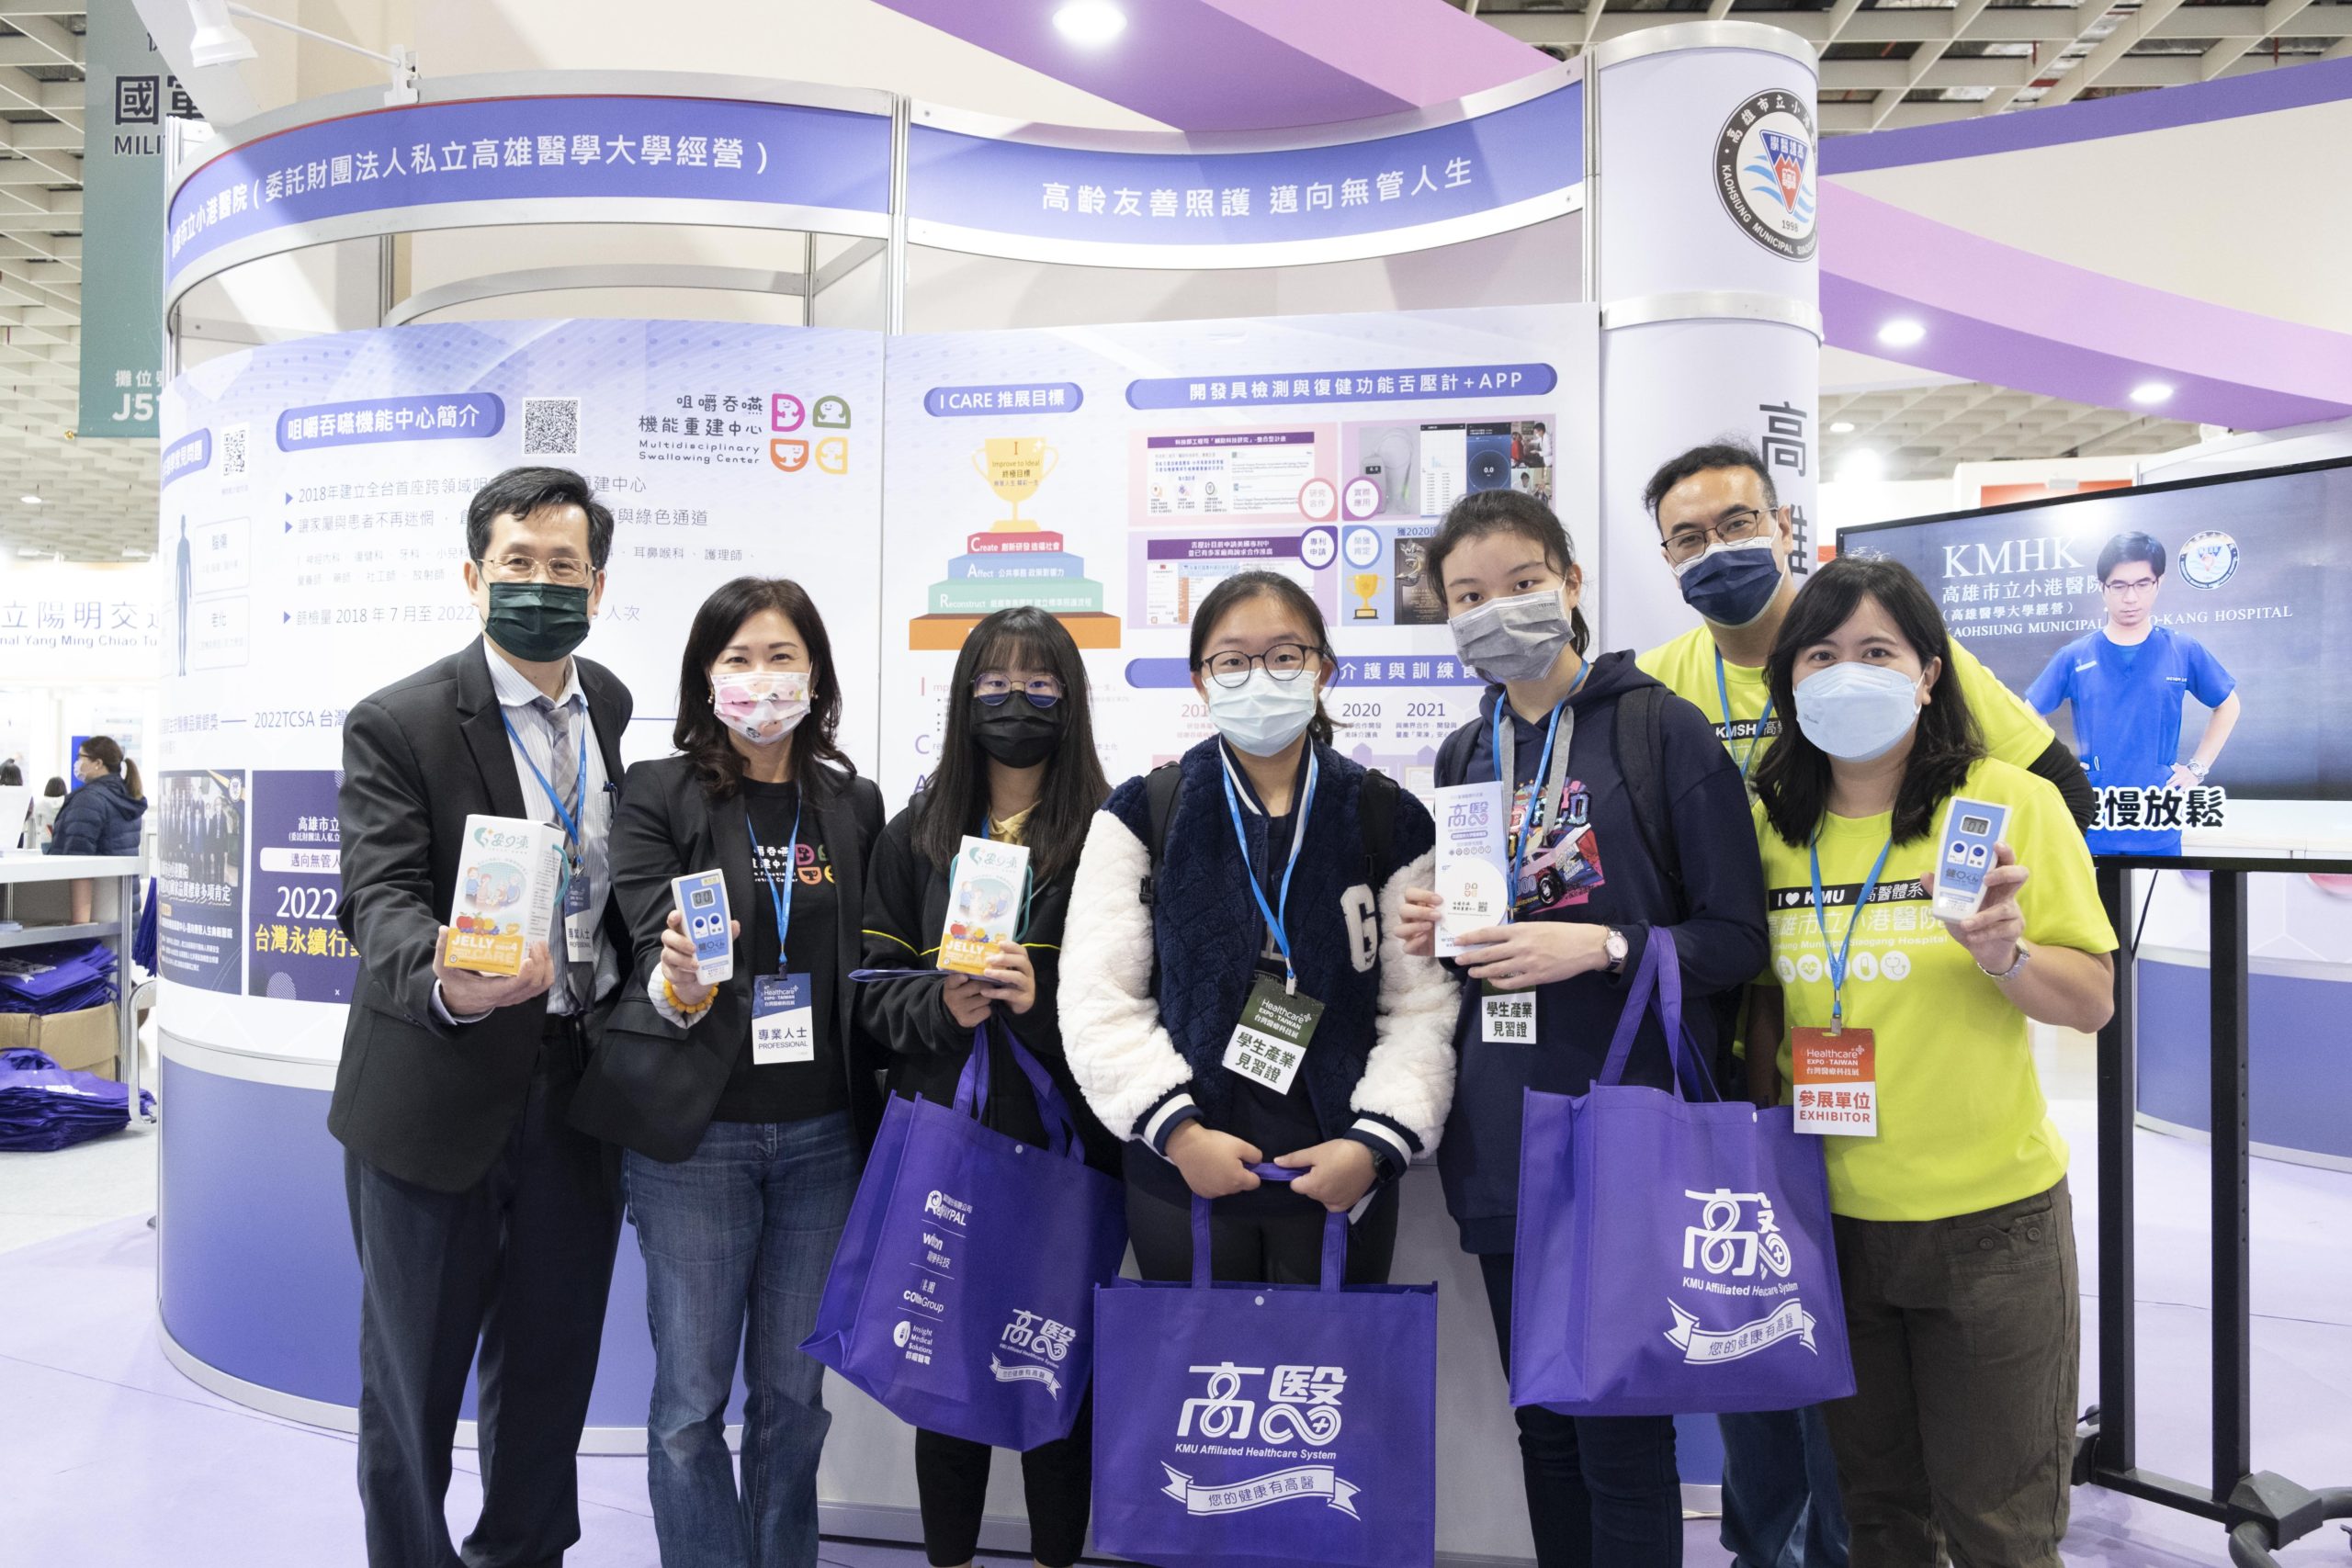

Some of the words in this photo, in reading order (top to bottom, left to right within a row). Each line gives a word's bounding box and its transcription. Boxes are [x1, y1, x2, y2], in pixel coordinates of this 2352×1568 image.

[114, 135, 165, 155] MILI
[1043, 182, 1251, 218] 高齡友善照護
[1269, 156, 1473, 216] 邁向無管人生
[1752, 222, 1794, 254] MUNICIPAL
[112, 392, 162, 422] J5
[940, 394, 944, 410] I
[949, 393, 993, 409] CARE
[997, 389, 1066, 408] 推展目標
[638, 415, 763, 436] 機能重建中心
[639, 440, 760, 455] Multidisciplinary
[639, 451, 710, 464] Swallowing
[717, 454, 760, 464] Center
[971, 536, 999, 551] Create
[1941, 536, 2086, 579] KMHK
[967, 563, 993, 578] Affect
[1941, 574, 2103, 604] 高雄市立小港醫院
[940, 593, 985, 609] Reconstruct
[1, 601, 159, 629] 立陽明交
[335, 605, 368, 624] 2018
[390, 607, 398, 622] 7
[437, 604, 475, 622] 2022
[2028, 618, 2105, 634] MUNICIPAL
[2214, 605, 2294, 623] HOSPITAL
[26, 635, 56, 648] Yang
[62, 635, 93, 648] Ming
[98, 635, 137, 647] Chiao
[1182, 705, 1208, 718] 201
[1341, 703, 1381, 717] 2020
[1407, 703, 1446, 717] 2021
[298, 816, 340, 832] 高雄市立
[276, 886, 337, 920] 2022
[1804, 890, 1845, 905] KMU
[451, 935, 494, 949] JELLY
[946, 940, 985, 954] JELLY
[1898, 935, 1948, 945] Hospital
[763, 988, 795, 997] Healthcare
[1258, 1007, 1274, 1019] EXPO
[1276, 1014, 1303, 1031] TAIWAN
[1261, 998, 1306, 1023] Healthcare
[1486, 1001, 1533, 1019] 學生產業
[758, 1026, 808, 1041] 專業人士
[1492, 1021, 1528, 1039] 見習證
[758, 1040, 808, 1051] PROFESSIONAL
[1236, 1031, 1297, 1069] 學生產業
[1806, 1048, 1858, 1058] Healthcare
[1234, 1052, 1283, 1084] 見習證
[1829, 1058, 1859, 1066] TAIWAN
[1799, 1089, 1871, 1110] 參展單位
[1799, 1110, 1871, 1123] EXHIBITOR
[1682, 1275, 1704, 1291] KMU
[1705, 1279, 1751, 1297] Affiliated
[912, 1325, 933, 1336] Insight
[908, 1342, 933, 1355] Solutions
[910, 1334, 933, 1346] Medical
[1176, 1360, 1348, 1447] 高醫
[1174, 1442, 1198, 1454] KMU
[1200, 1444, 1243, 1457] Affiliated
[1245, 1446, 1298, 1459] Healthcare
[1299, 1449, 1338, 1461] System
[1208, 1475, 1315, 1507] 您的健康有高醫
